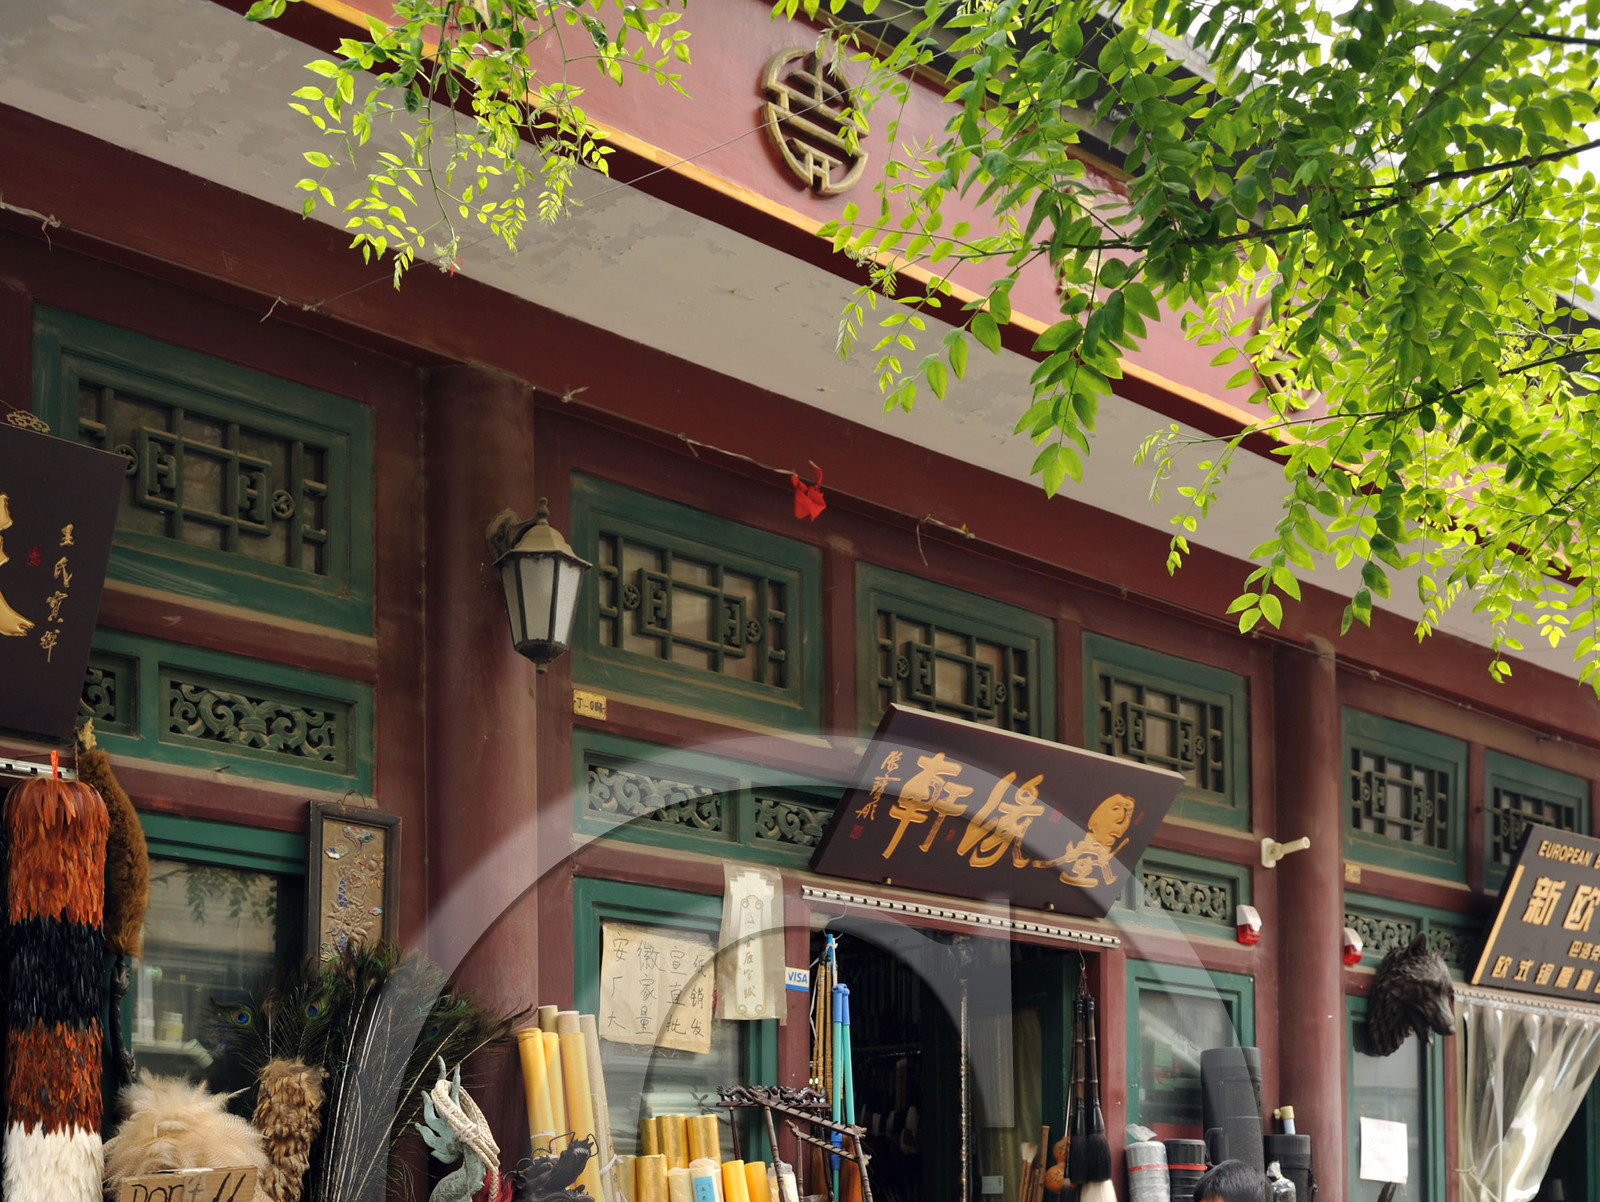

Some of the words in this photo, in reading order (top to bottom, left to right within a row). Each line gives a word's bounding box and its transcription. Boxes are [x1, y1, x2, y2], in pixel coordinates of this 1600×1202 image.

[1538, 840, 1594, 867] EUROPEAN
[610, 974, 704, 1011] 厂家直销
[788, 971, 809, 984] VISA
[607, 1005, 705, 1038] 大量批发
